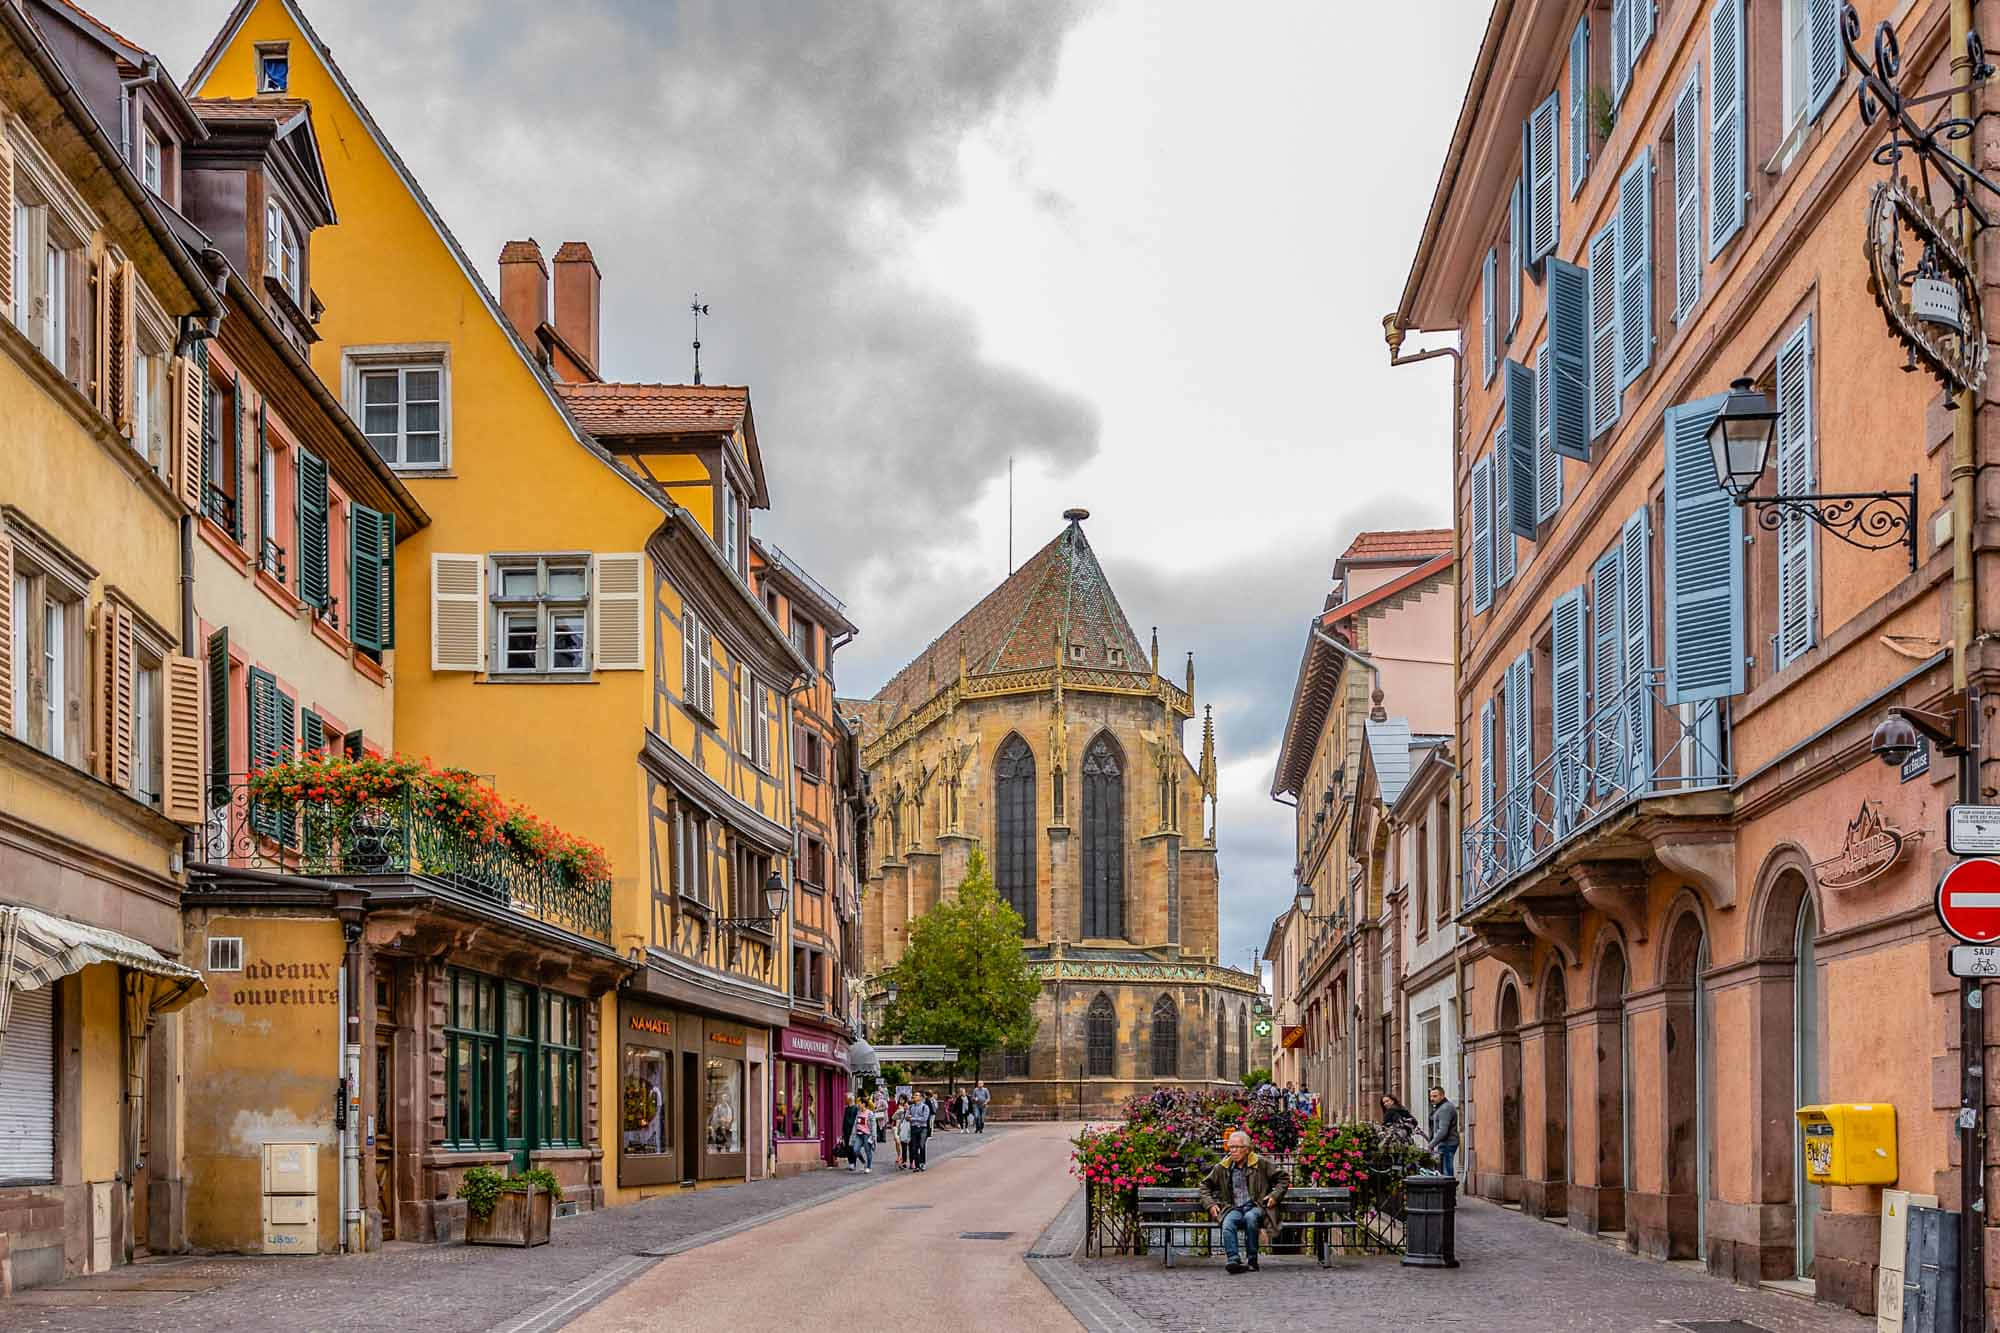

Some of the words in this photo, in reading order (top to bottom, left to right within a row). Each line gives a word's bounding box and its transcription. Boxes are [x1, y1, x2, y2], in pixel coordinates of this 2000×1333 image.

[1973, 947, 1995, 956] SAUF
[245, 958, 331, 980] adeaux
[233, 983, 340, 1006] ouvenirs
[631, 1015, 671, 1036] NAMASTE
